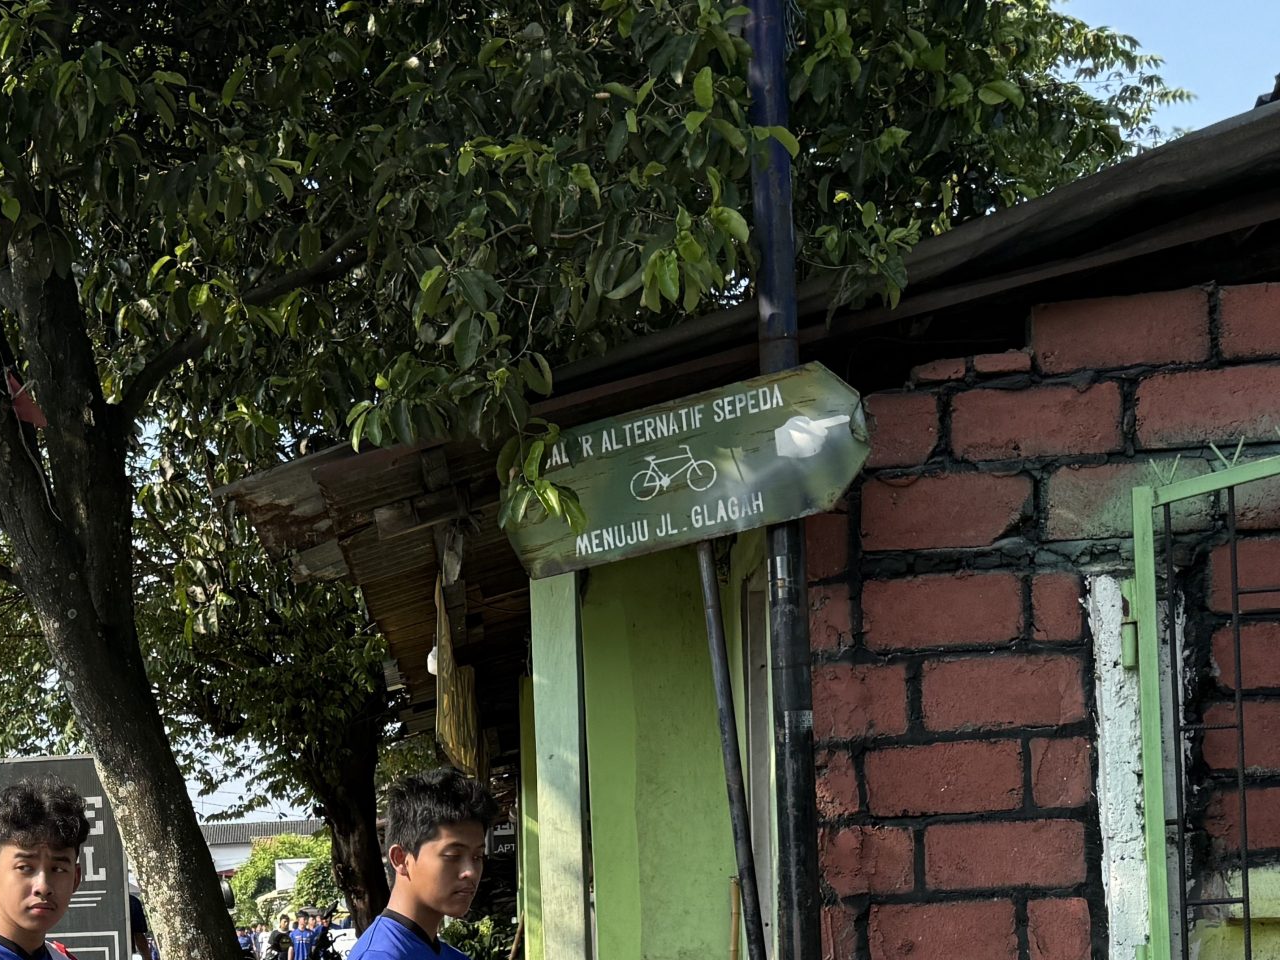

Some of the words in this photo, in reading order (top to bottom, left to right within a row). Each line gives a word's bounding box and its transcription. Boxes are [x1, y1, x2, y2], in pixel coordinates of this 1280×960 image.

[545, 434, 593, 469] ALR
[601, 404, 704, 453] ALTERNATIF
[712, 384, 784, 423] SEPEDA
[576, 519, 649, 557] MENUJU
[691, 491, 764, 528] GLAGAH
